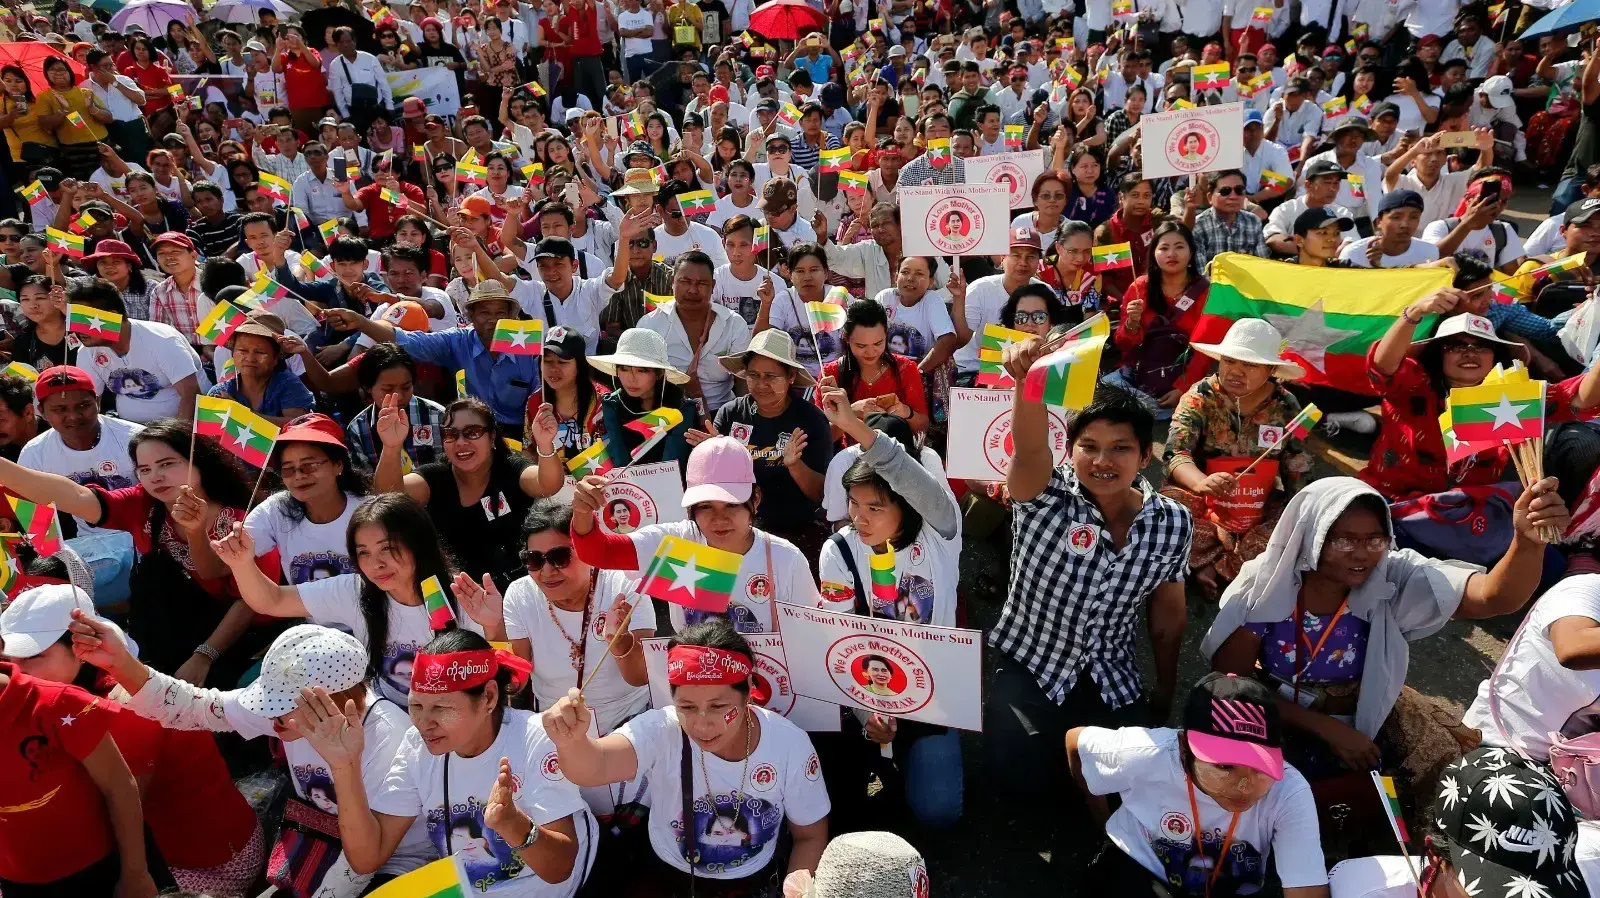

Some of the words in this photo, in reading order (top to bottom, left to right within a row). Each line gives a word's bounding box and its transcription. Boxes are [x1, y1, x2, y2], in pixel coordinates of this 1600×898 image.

[1188, 123, 1212, 134] Mother
[929, 218, 937, 231] We
[934, 203, 949, 218] Love
[950, 200, 976, 214] Mother
[973, 214, 981, 229] Suu
[935, 237, 975, 251] MYANMAR
[957, 392, 971, 401] We
[973, 393, 1000, 402] Stand
[989, 433, 1001, 449] We
[1054, 431, 1064, 451] Suu
[630, 469, 657, 477] Mother
[1243, 486, 1264, 497] Light
[612, 487, 644, 500] Mother
[642, 500, 653, 518] Suu
[783, 607, 801, 618] We
[803, 611, 835, 626] Stand
[838, 618, 867, 631] With
[870, 623, 898, 636] You,
[901, 627, 946, 642] Mother
[948, 634, 973, 645] Suu
[650, 643, 668, 652] We
[839, 641, 867, 660] Love
[868, 640, 914, 666] Mother
[834, 659, 846, 675] We
[756, 659, 779, 676] ther
[776, 675, 789, 696] Suu
[912, 668, 926, 689] Suu
[846, 684, 916, 710] MYANMAR
[1237, 724, 1264, 737] WHITE
